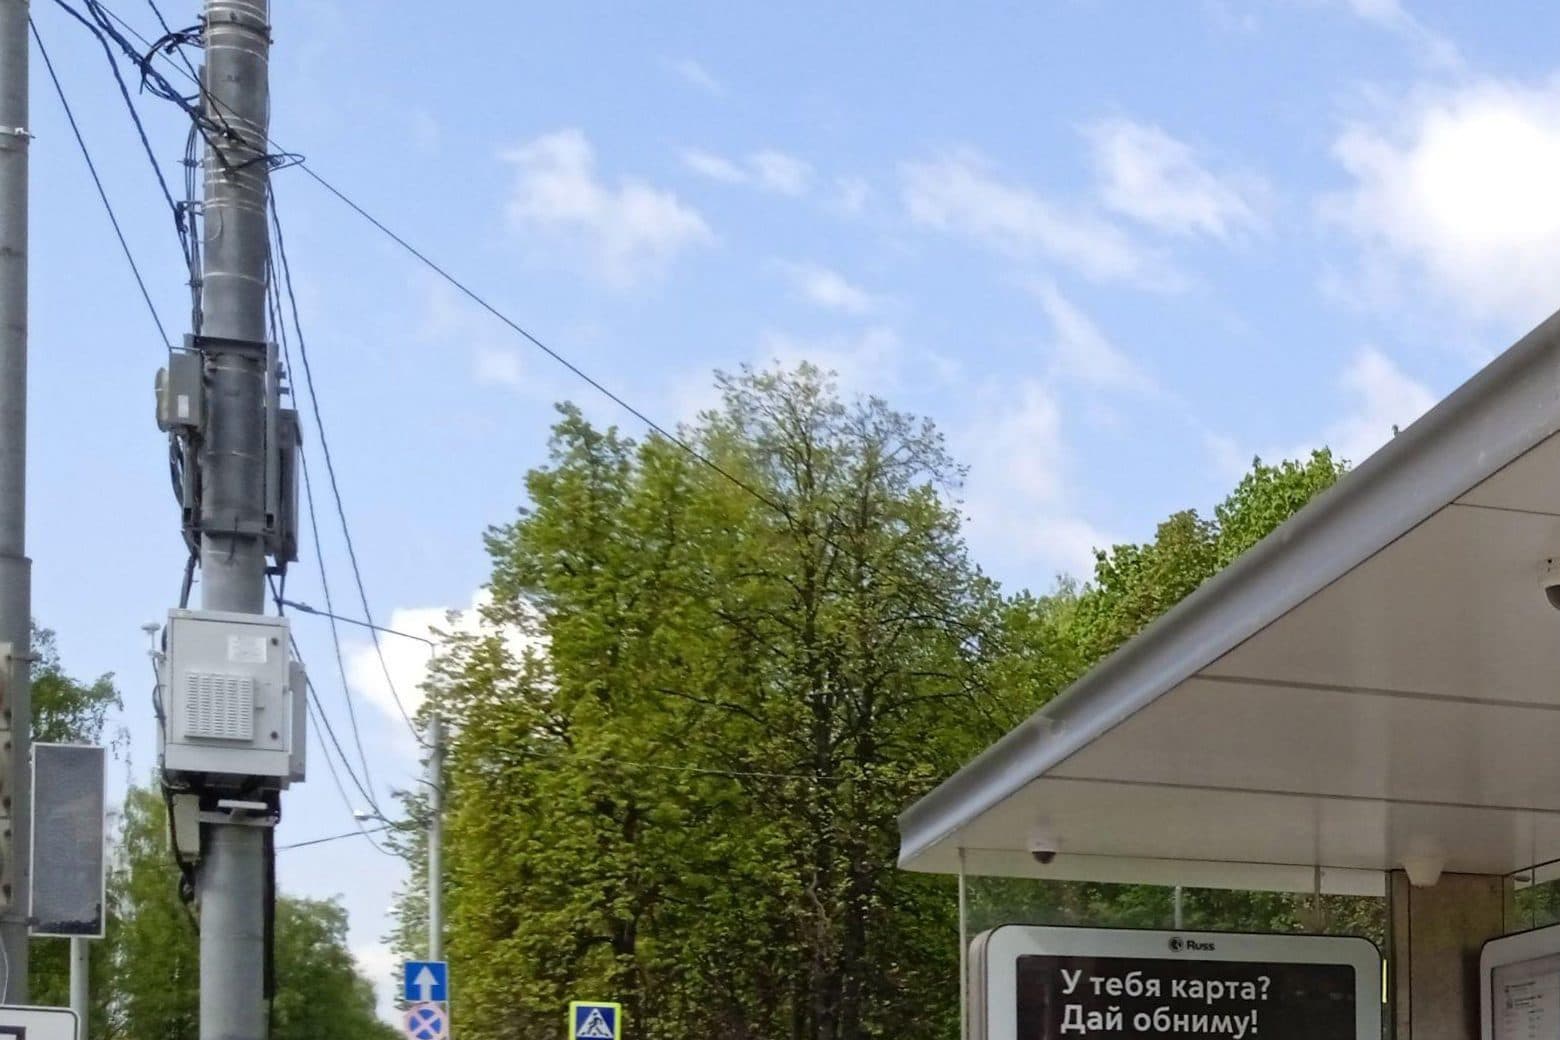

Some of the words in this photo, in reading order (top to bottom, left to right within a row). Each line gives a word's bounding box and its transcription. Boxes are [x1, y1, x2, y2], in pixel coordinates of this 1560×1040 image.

[1187, 940, 1216, 952] Russ
[1061, 970, 1082, 994] У
[1090, 970, 1161, 998] тебя
[1172, 975, 1271, 1004] карта?
[1060, 1004, 1122, 1034] Дай
[1134, 1007, 1258, 1040] обниму!
